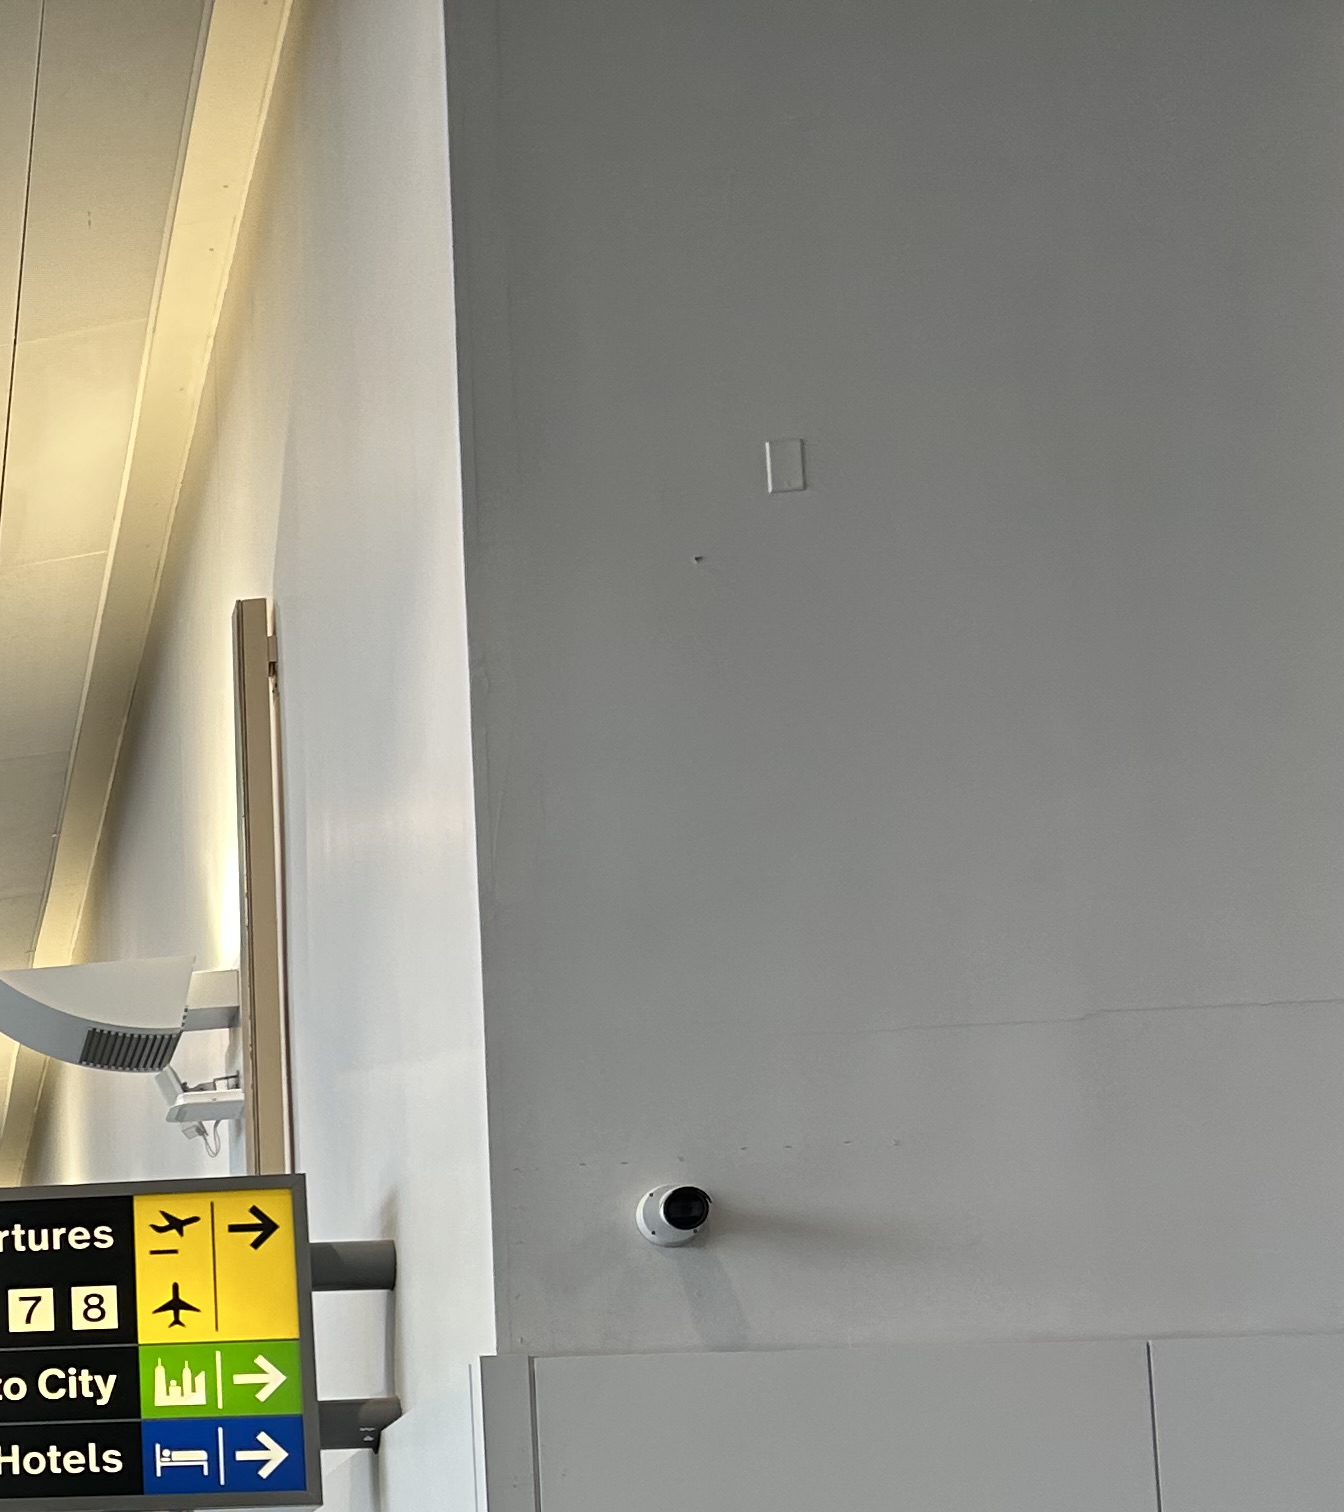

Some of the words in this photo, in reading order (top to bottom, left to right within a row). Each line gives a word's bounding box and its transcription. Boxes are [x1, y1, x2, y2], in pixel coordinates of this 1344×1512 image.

[19, 1295, 42, 1325] 7
[82, 1293, 106, 1323] 8
[37, 1367, 117, 1406] City
